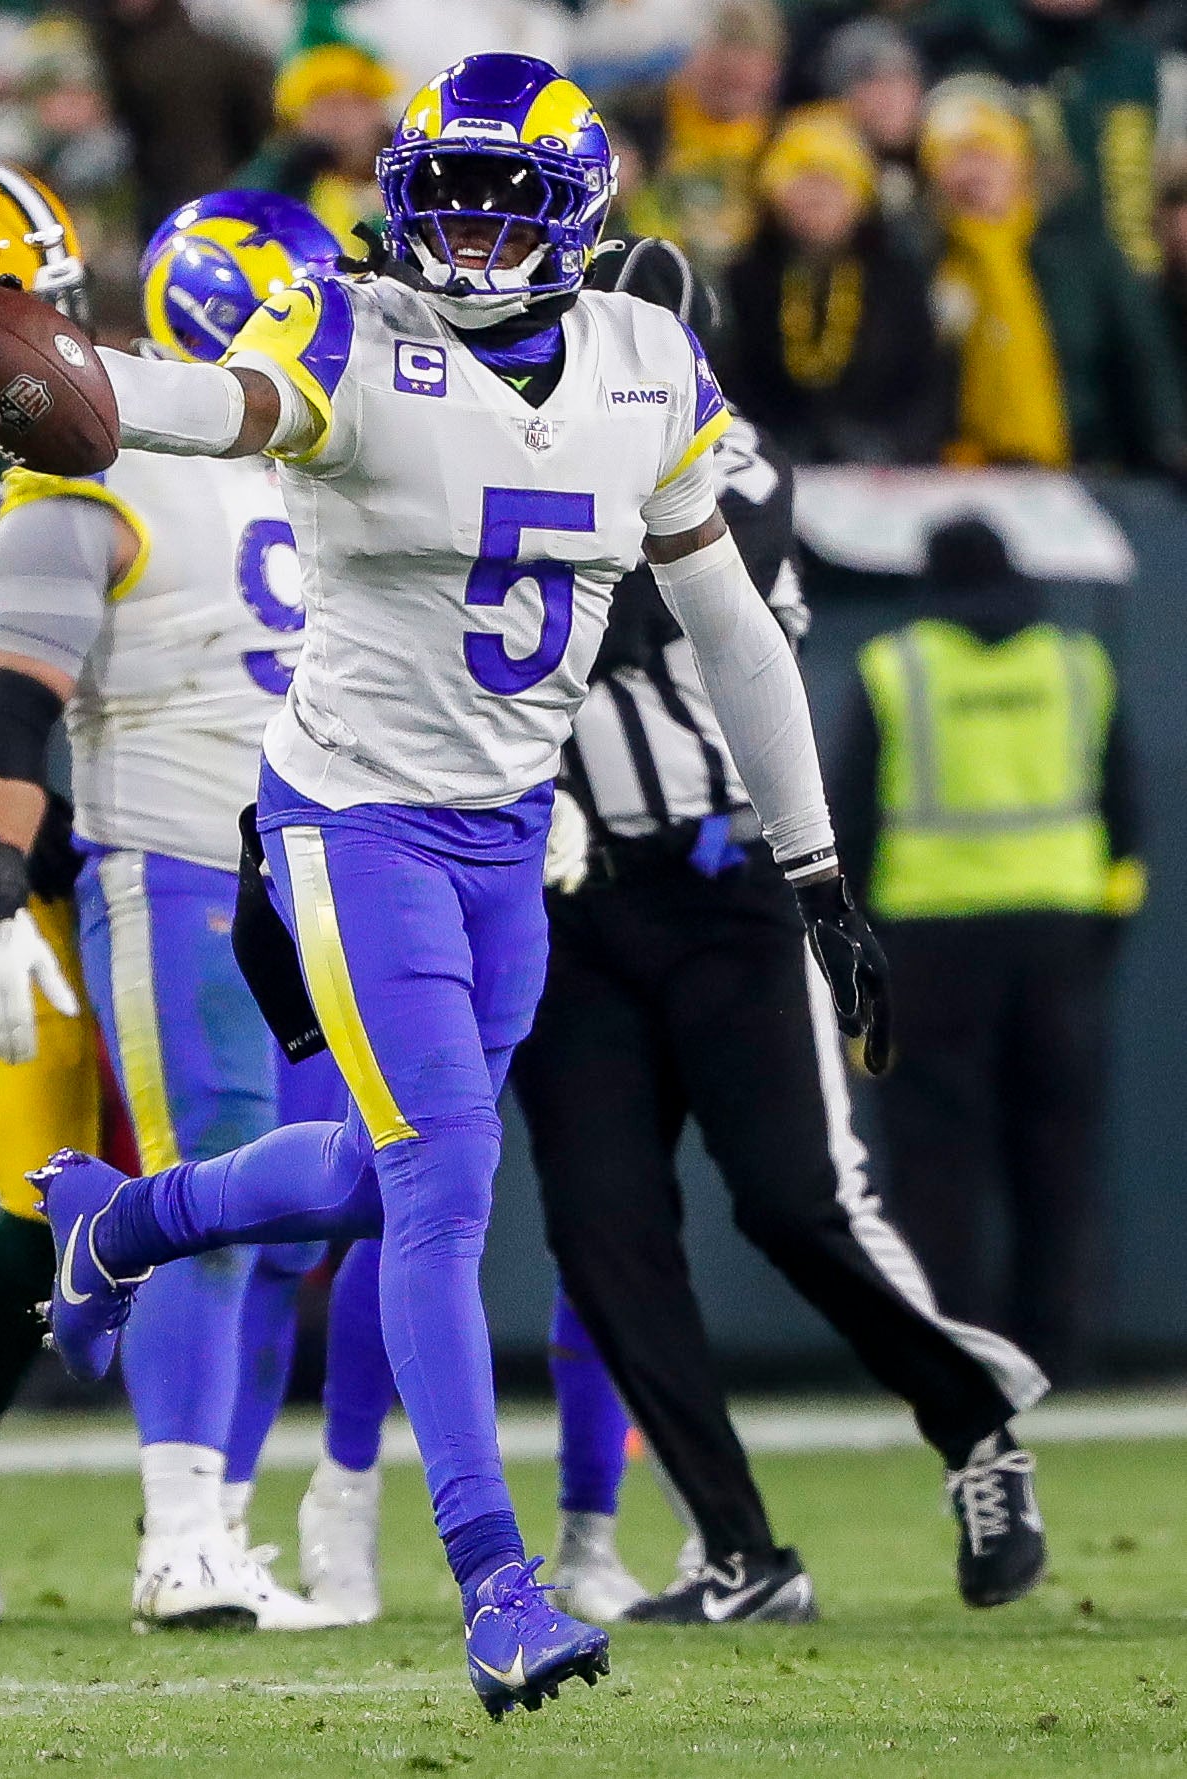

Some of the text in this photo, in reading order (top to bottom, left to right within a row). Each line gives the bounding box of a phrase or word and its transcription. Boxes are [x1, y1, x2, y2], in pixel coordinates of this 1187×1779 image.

[397, 343, 445, 384] C
[610, 389, 669, 405] RAMS
[463, 486, 596, 696] 5
